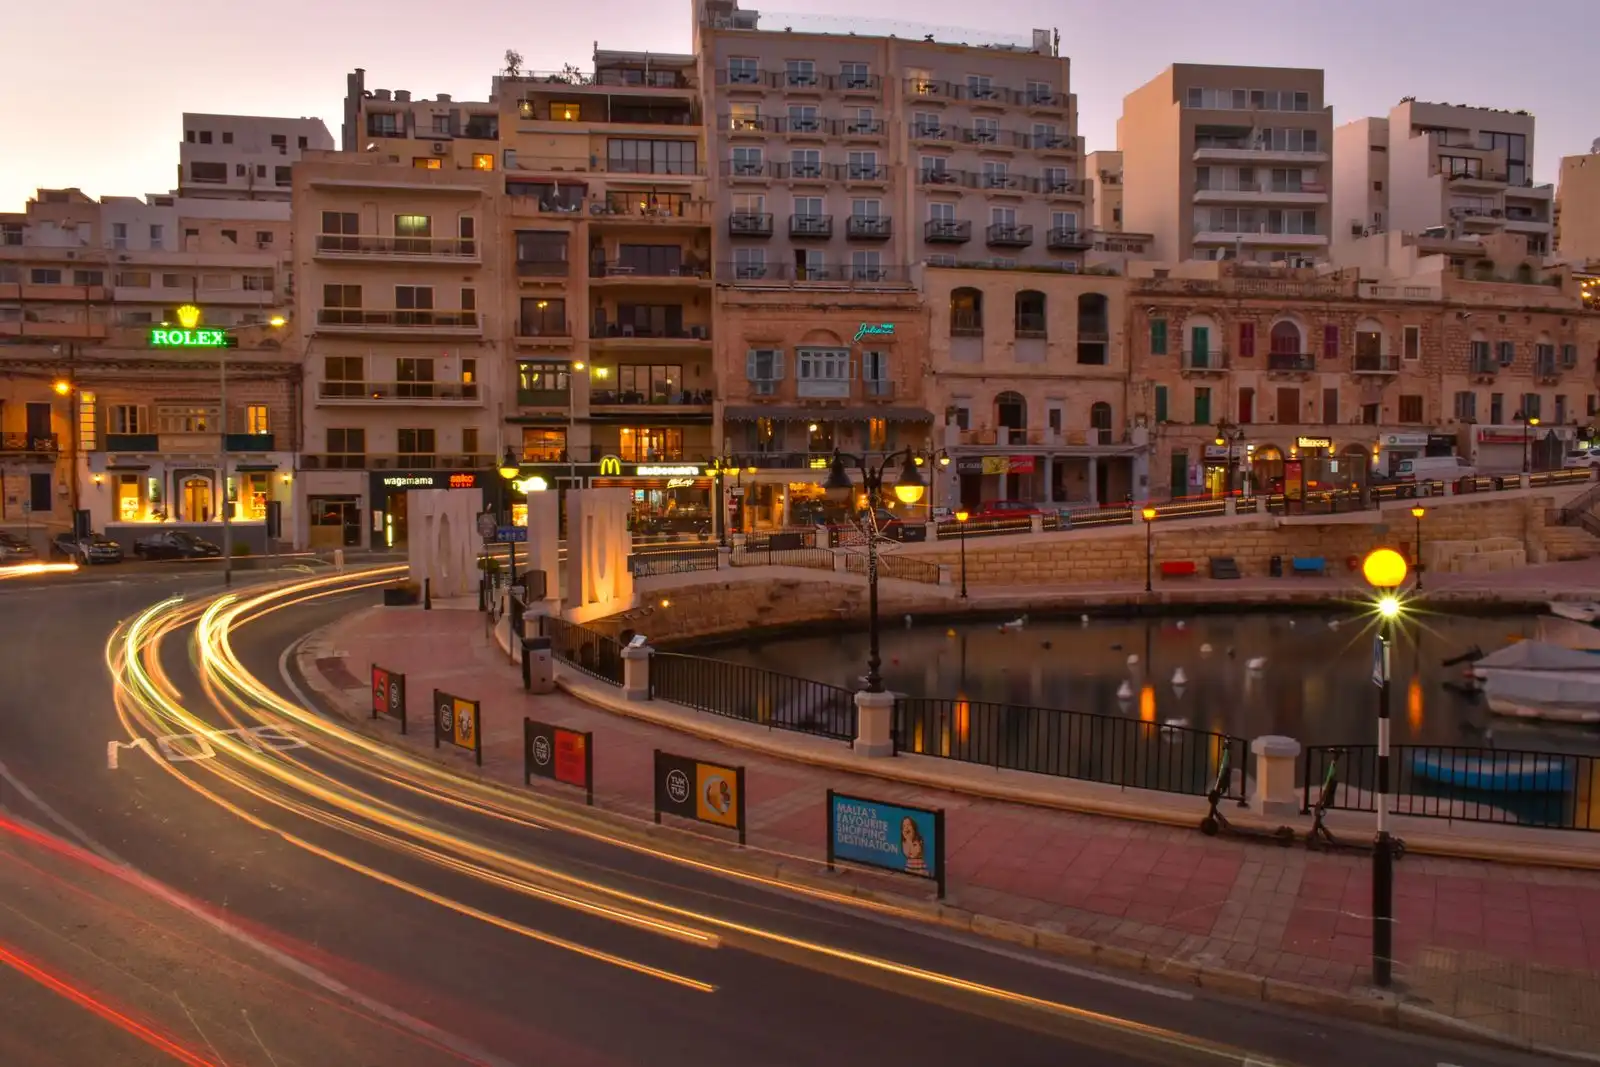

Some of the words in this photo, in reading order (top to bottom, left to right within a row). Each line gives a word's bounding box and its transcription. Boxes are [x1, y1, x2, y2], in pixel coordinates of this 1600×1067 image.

[152, 330, 227, 345] ROLEX
[384, 476, 433, 487] wagamama
[671, 775, 685, 786] TUK
[671, 786, 685, 796] TUK
[837, 803, 876, 818] MALTA'S
[837, 813, 888, 831] FAVOURITE
[837, 823, 887, 841] SHOPPING
[837, 833, 898, 854] DESTINATION
